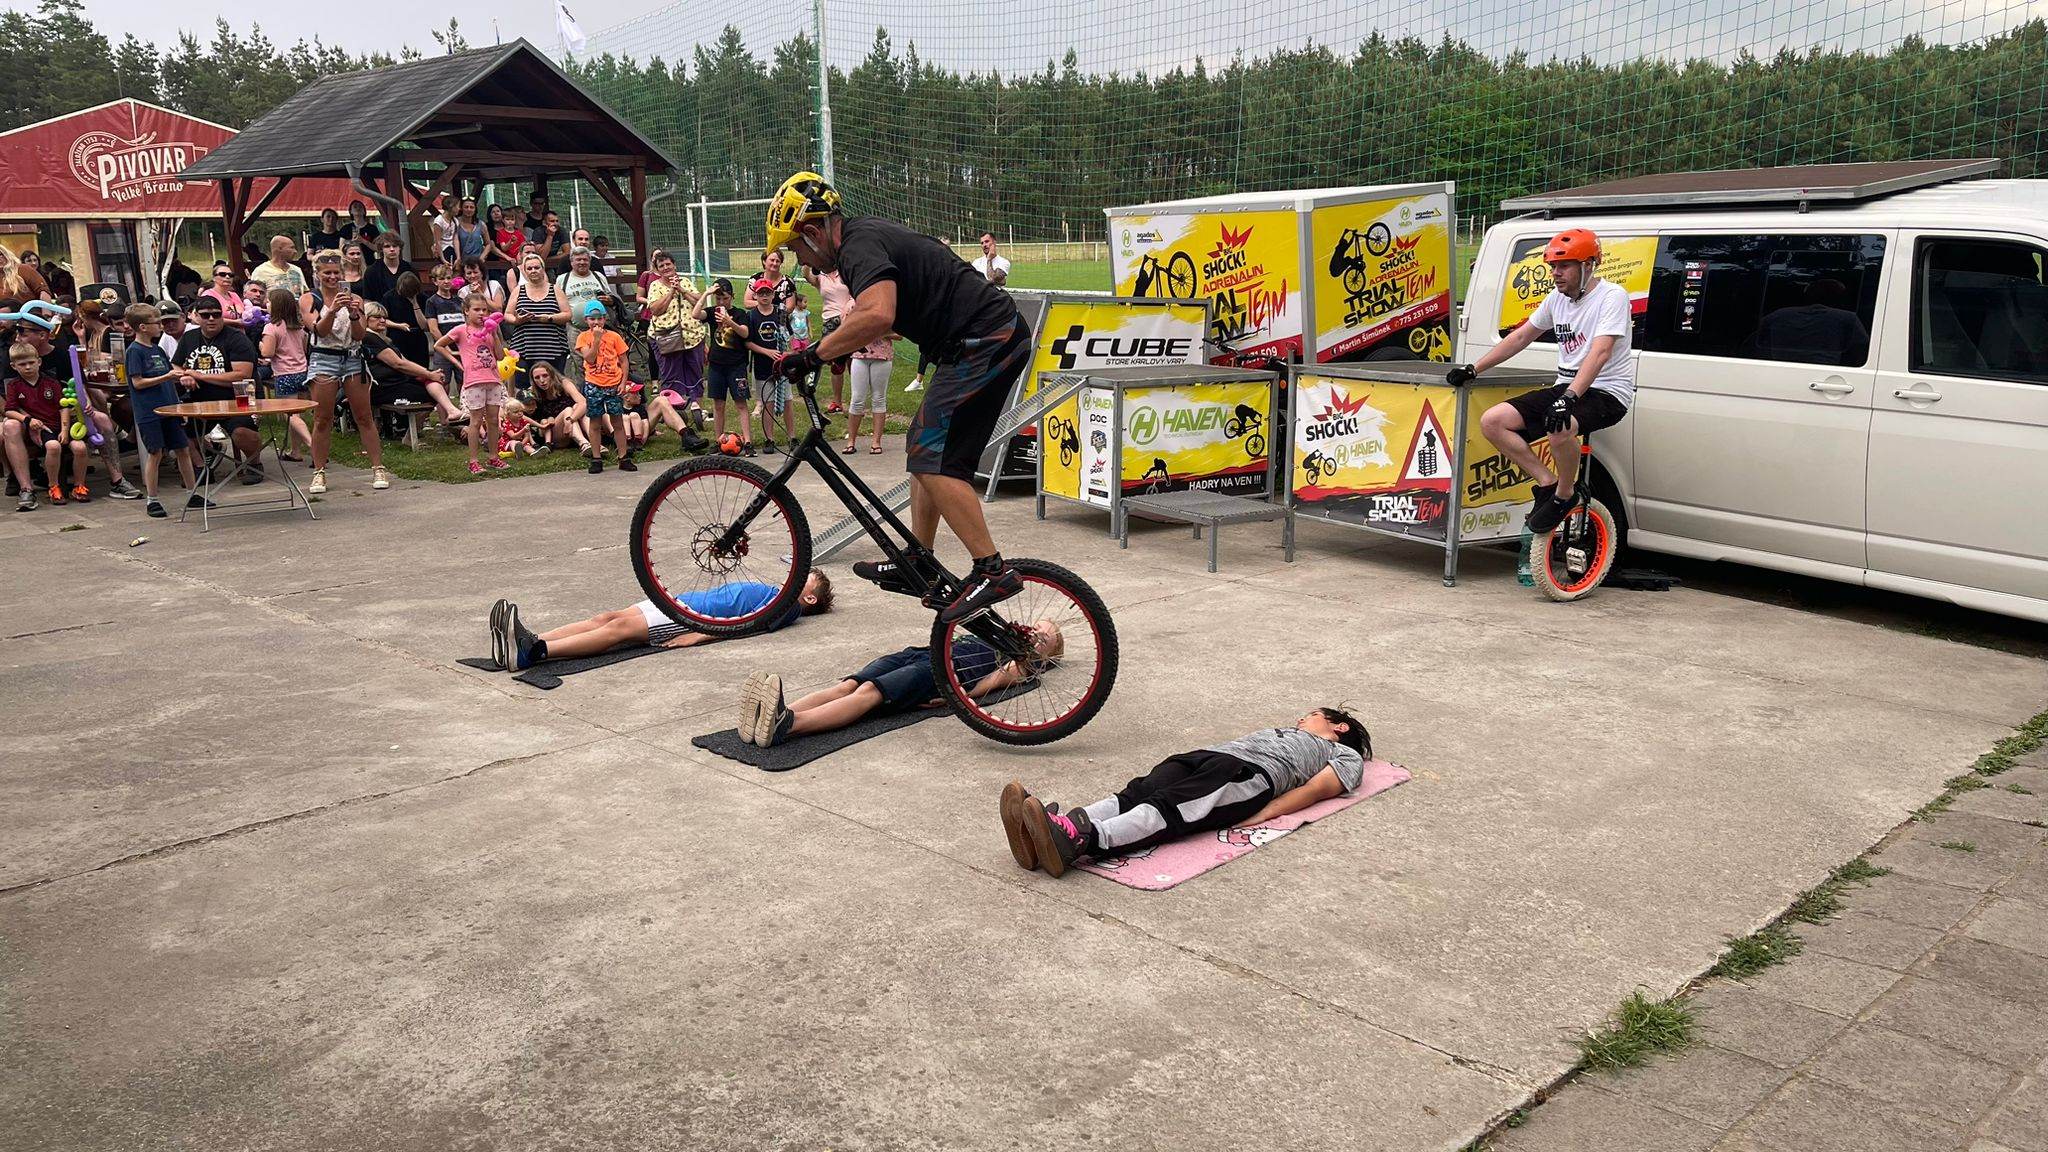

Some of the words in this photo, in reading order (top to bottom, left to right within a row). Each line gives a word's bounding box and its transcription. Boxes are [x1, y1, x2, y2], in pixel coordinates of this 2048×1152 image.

[97, 147, 187, 199] PIVOVAR
[111, 184, 141, 203] Velké
[143, 180, 184, 195] Březno
[1203, 250, 1246, 280] SHOCK!
[1368, 260, 1420, 287] ADRENALIN
[1379, 250, 1415, 274] SHOCK!
[1203, 264, 1265, 294] ADRENALIN
[1343, 278, 1405, 312] TRIAL
[1397, 265, 1436, 302] TEAM
[1236, 278, 1288, 337] TEAM
[1343, 291, 1406, 329] SHOW
[1338, 338, 1361, 353] Martin
[1361, 324, 1392, 342] Šimůnek
[1399, 316, 1412, 326] 775
[1412, 309, 1424, 321] 231
[1425, 302, 1439, 314] 509
[1085, 338, 1193, 357] CUBE
[1260, 346, 1278, 357] 509
[1563, 332, 1587, 354] TEAM
[1105, 358, 1131, 366] STORE
[1163, 407, 1228, 433] HAVEN
[1305, 417, 1359, 442] SHOCK!
[1350, 439, 1383, 457] HAVEN
[1188, 479, 1220, 491] HADRY
[1221, 477, 1233, 487] NA
[1234, 476, 1253, 486] VEN
[1368, 509, 1418, 523] SHOW
[1371, 496, 1418, 510] TRIAL
[1412, 496, 1444, 526] TEAM
[1479, 511, 1511, 527] HAVEN
